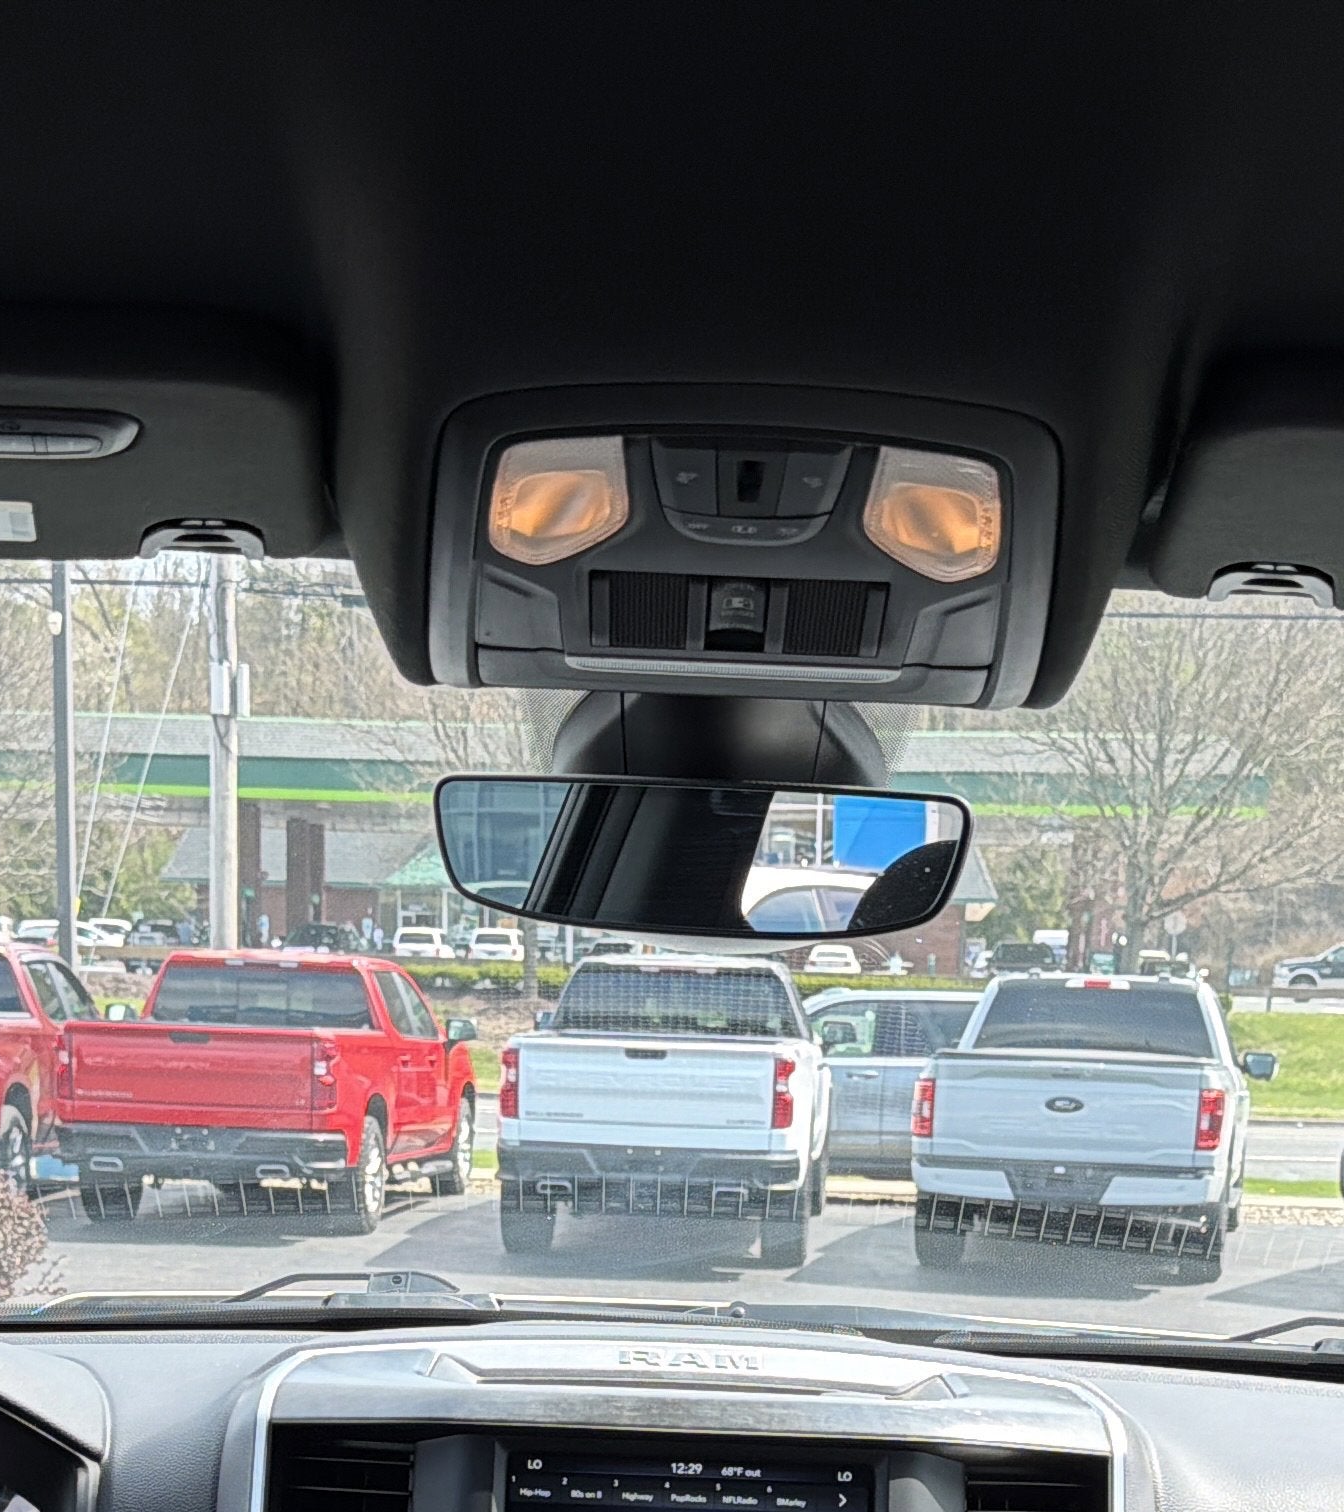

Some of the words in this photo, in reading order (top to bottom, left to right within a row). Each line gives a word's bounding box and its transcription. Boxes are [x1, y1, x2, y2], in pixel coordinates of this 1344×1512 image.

[619, 1348, 760, 1371] RAM
[527, 1459, 543, 1470] LO
[670, 1463, 703, 1475] 12:29
[745, 1468, 761, 1478] out
[511, 1475, 516, 1483] 1
[561, 1477, 568, 1485] 2
[837, 1471, 852, 1481] LO
[613, 1479, 619, 1487] 3
[664, 1481, 670, 1489] 4
[520, 1488, 551, 1498] Hip-Hop
[585, 1491, 595, 1499] on
[622, 1492, 653, 1502] Highway
